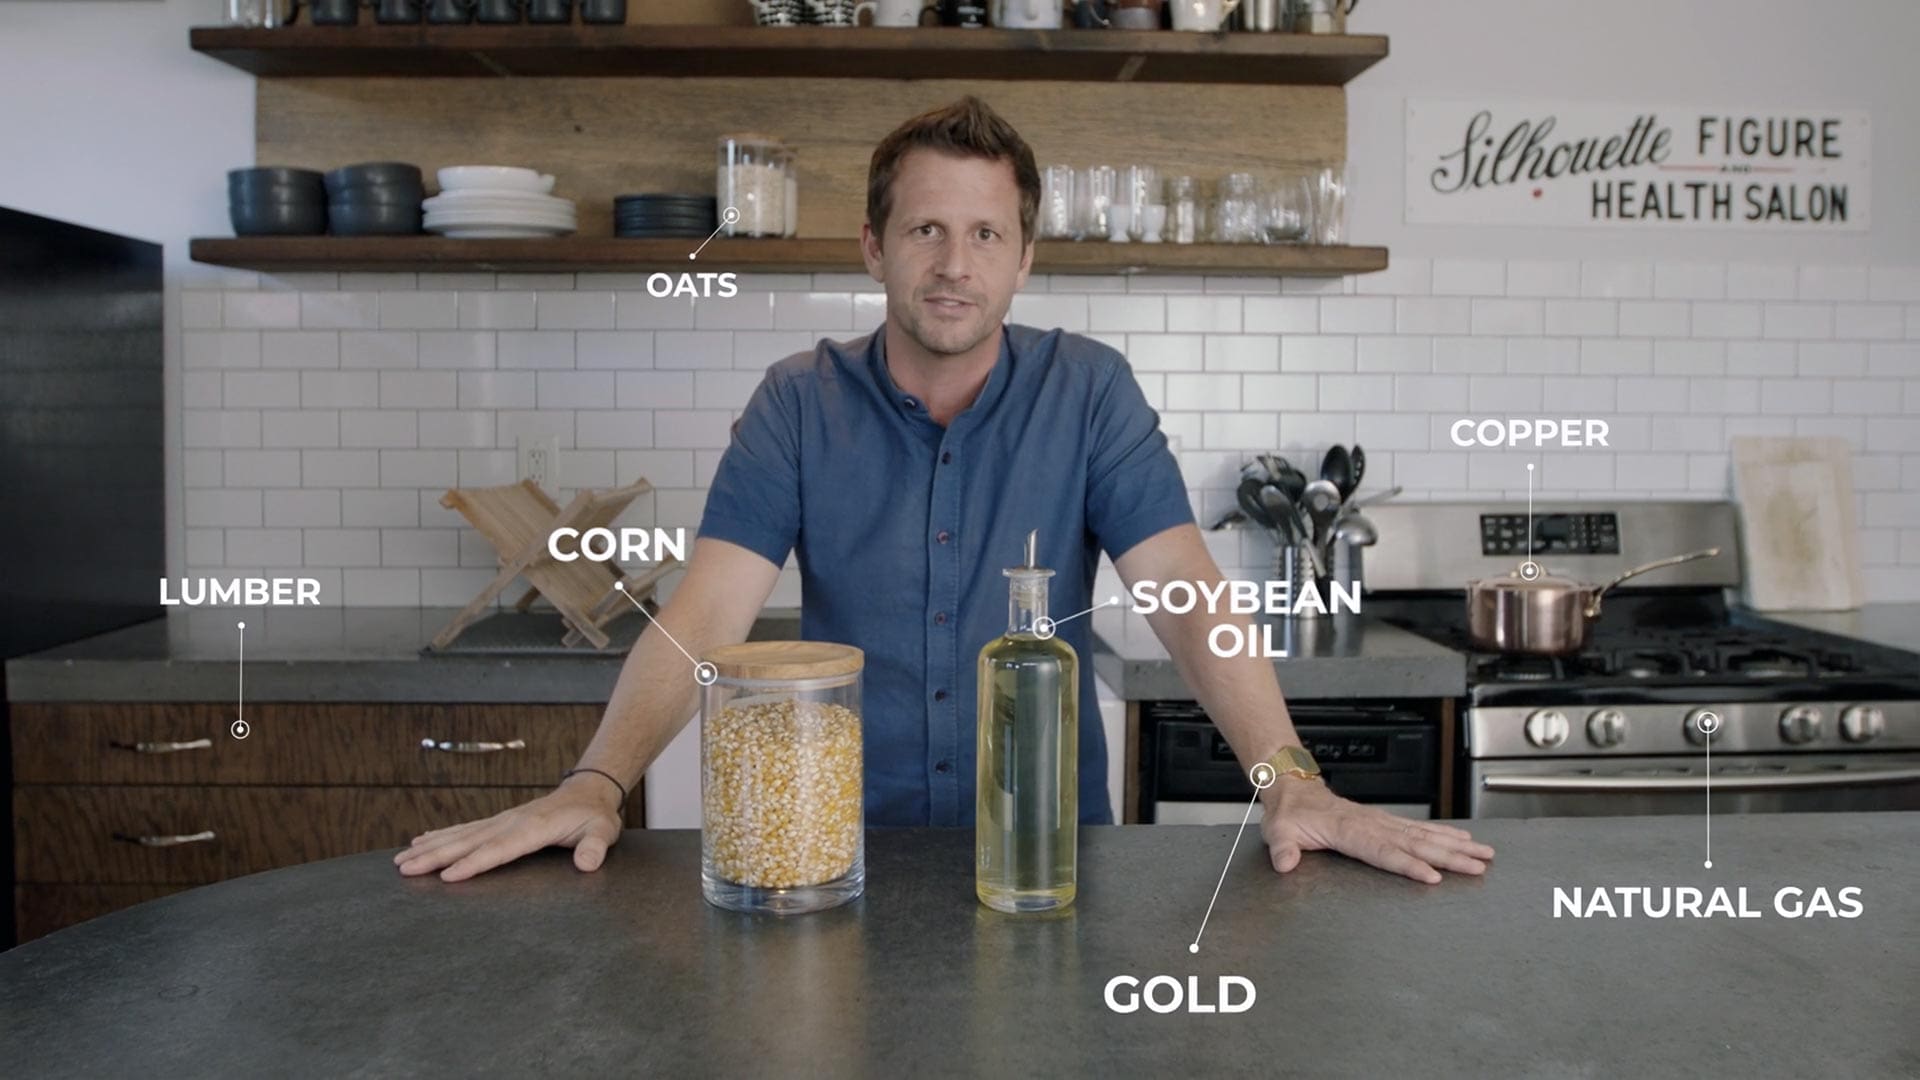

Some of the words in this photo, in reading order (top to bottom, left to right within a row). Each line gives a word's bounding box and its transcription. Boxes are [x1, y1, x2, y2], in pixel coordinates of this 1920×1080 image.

[1430, 110, 1672, 194] Silhouette
[1697, 116, 1842, 159] FIGURE
[1590, 181, 1733, 221] HEALTH
[1743, 184, 1849, 223] SALON
